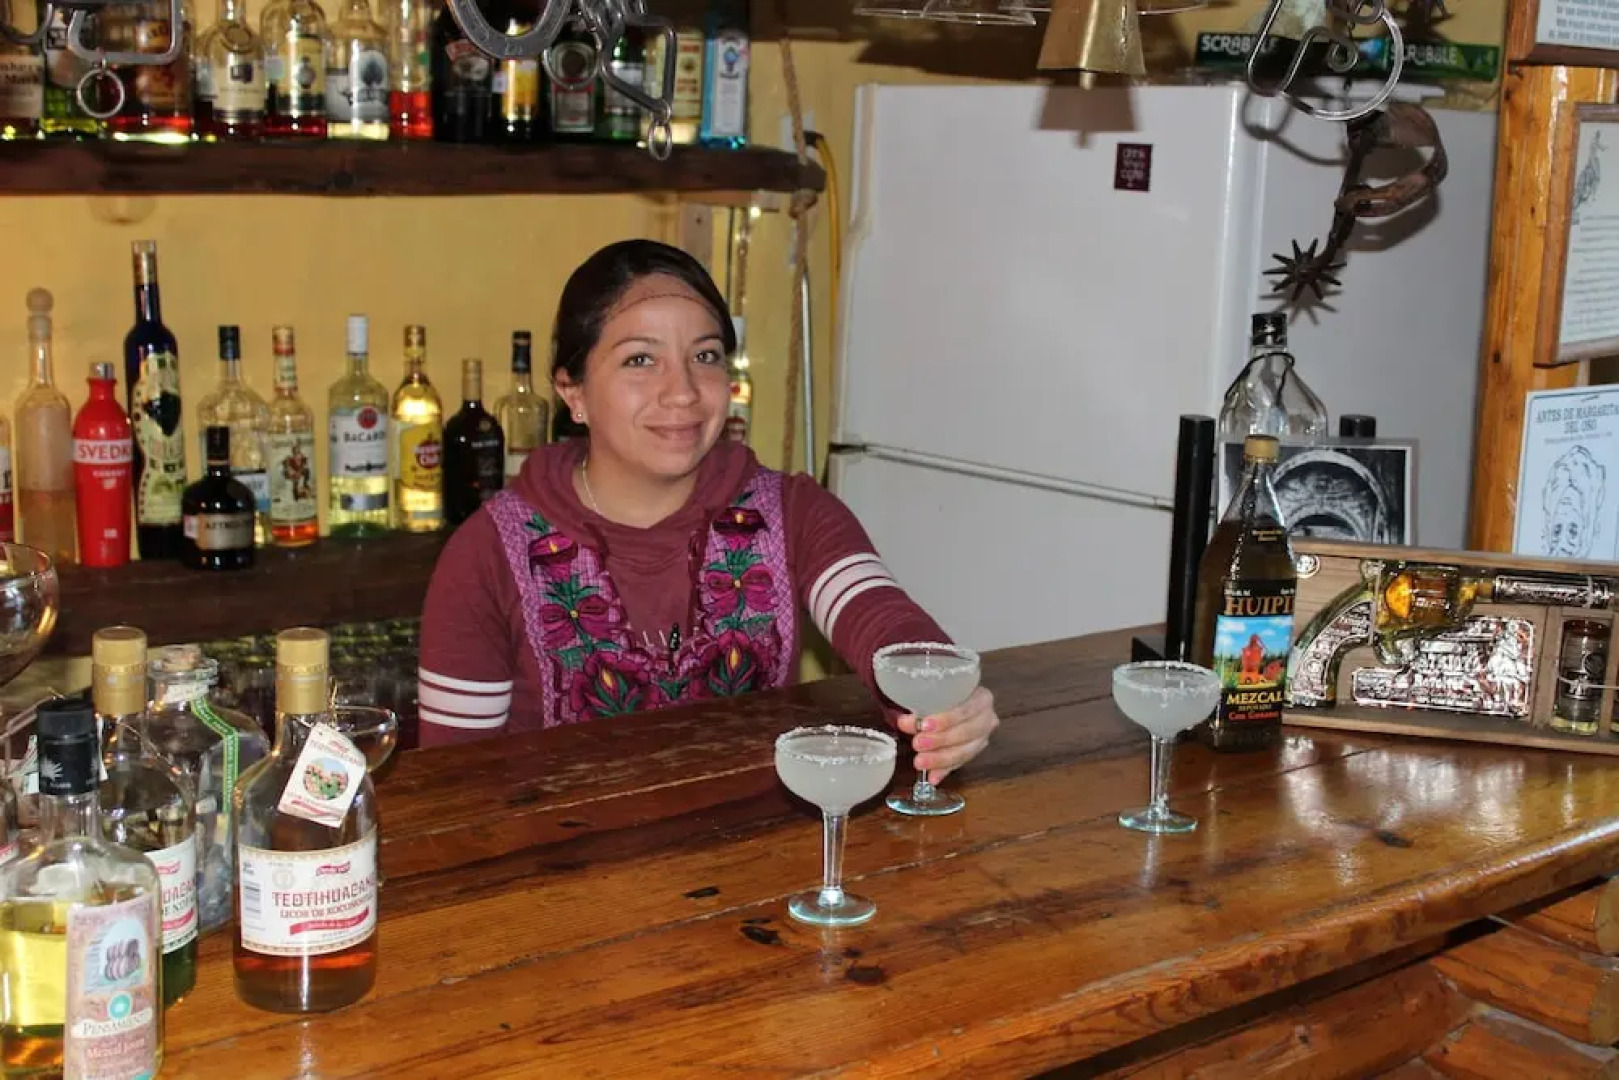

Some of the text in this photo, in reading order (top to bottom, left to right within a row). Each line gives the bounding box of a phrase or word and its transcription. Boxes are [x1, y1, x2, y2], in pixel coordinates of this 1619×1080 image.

[1390, 44, 1458, 65] SRABBLE
[1563, 408, 1575, 420] DE
[1227, 691, 1283, 704] MEZCAL
